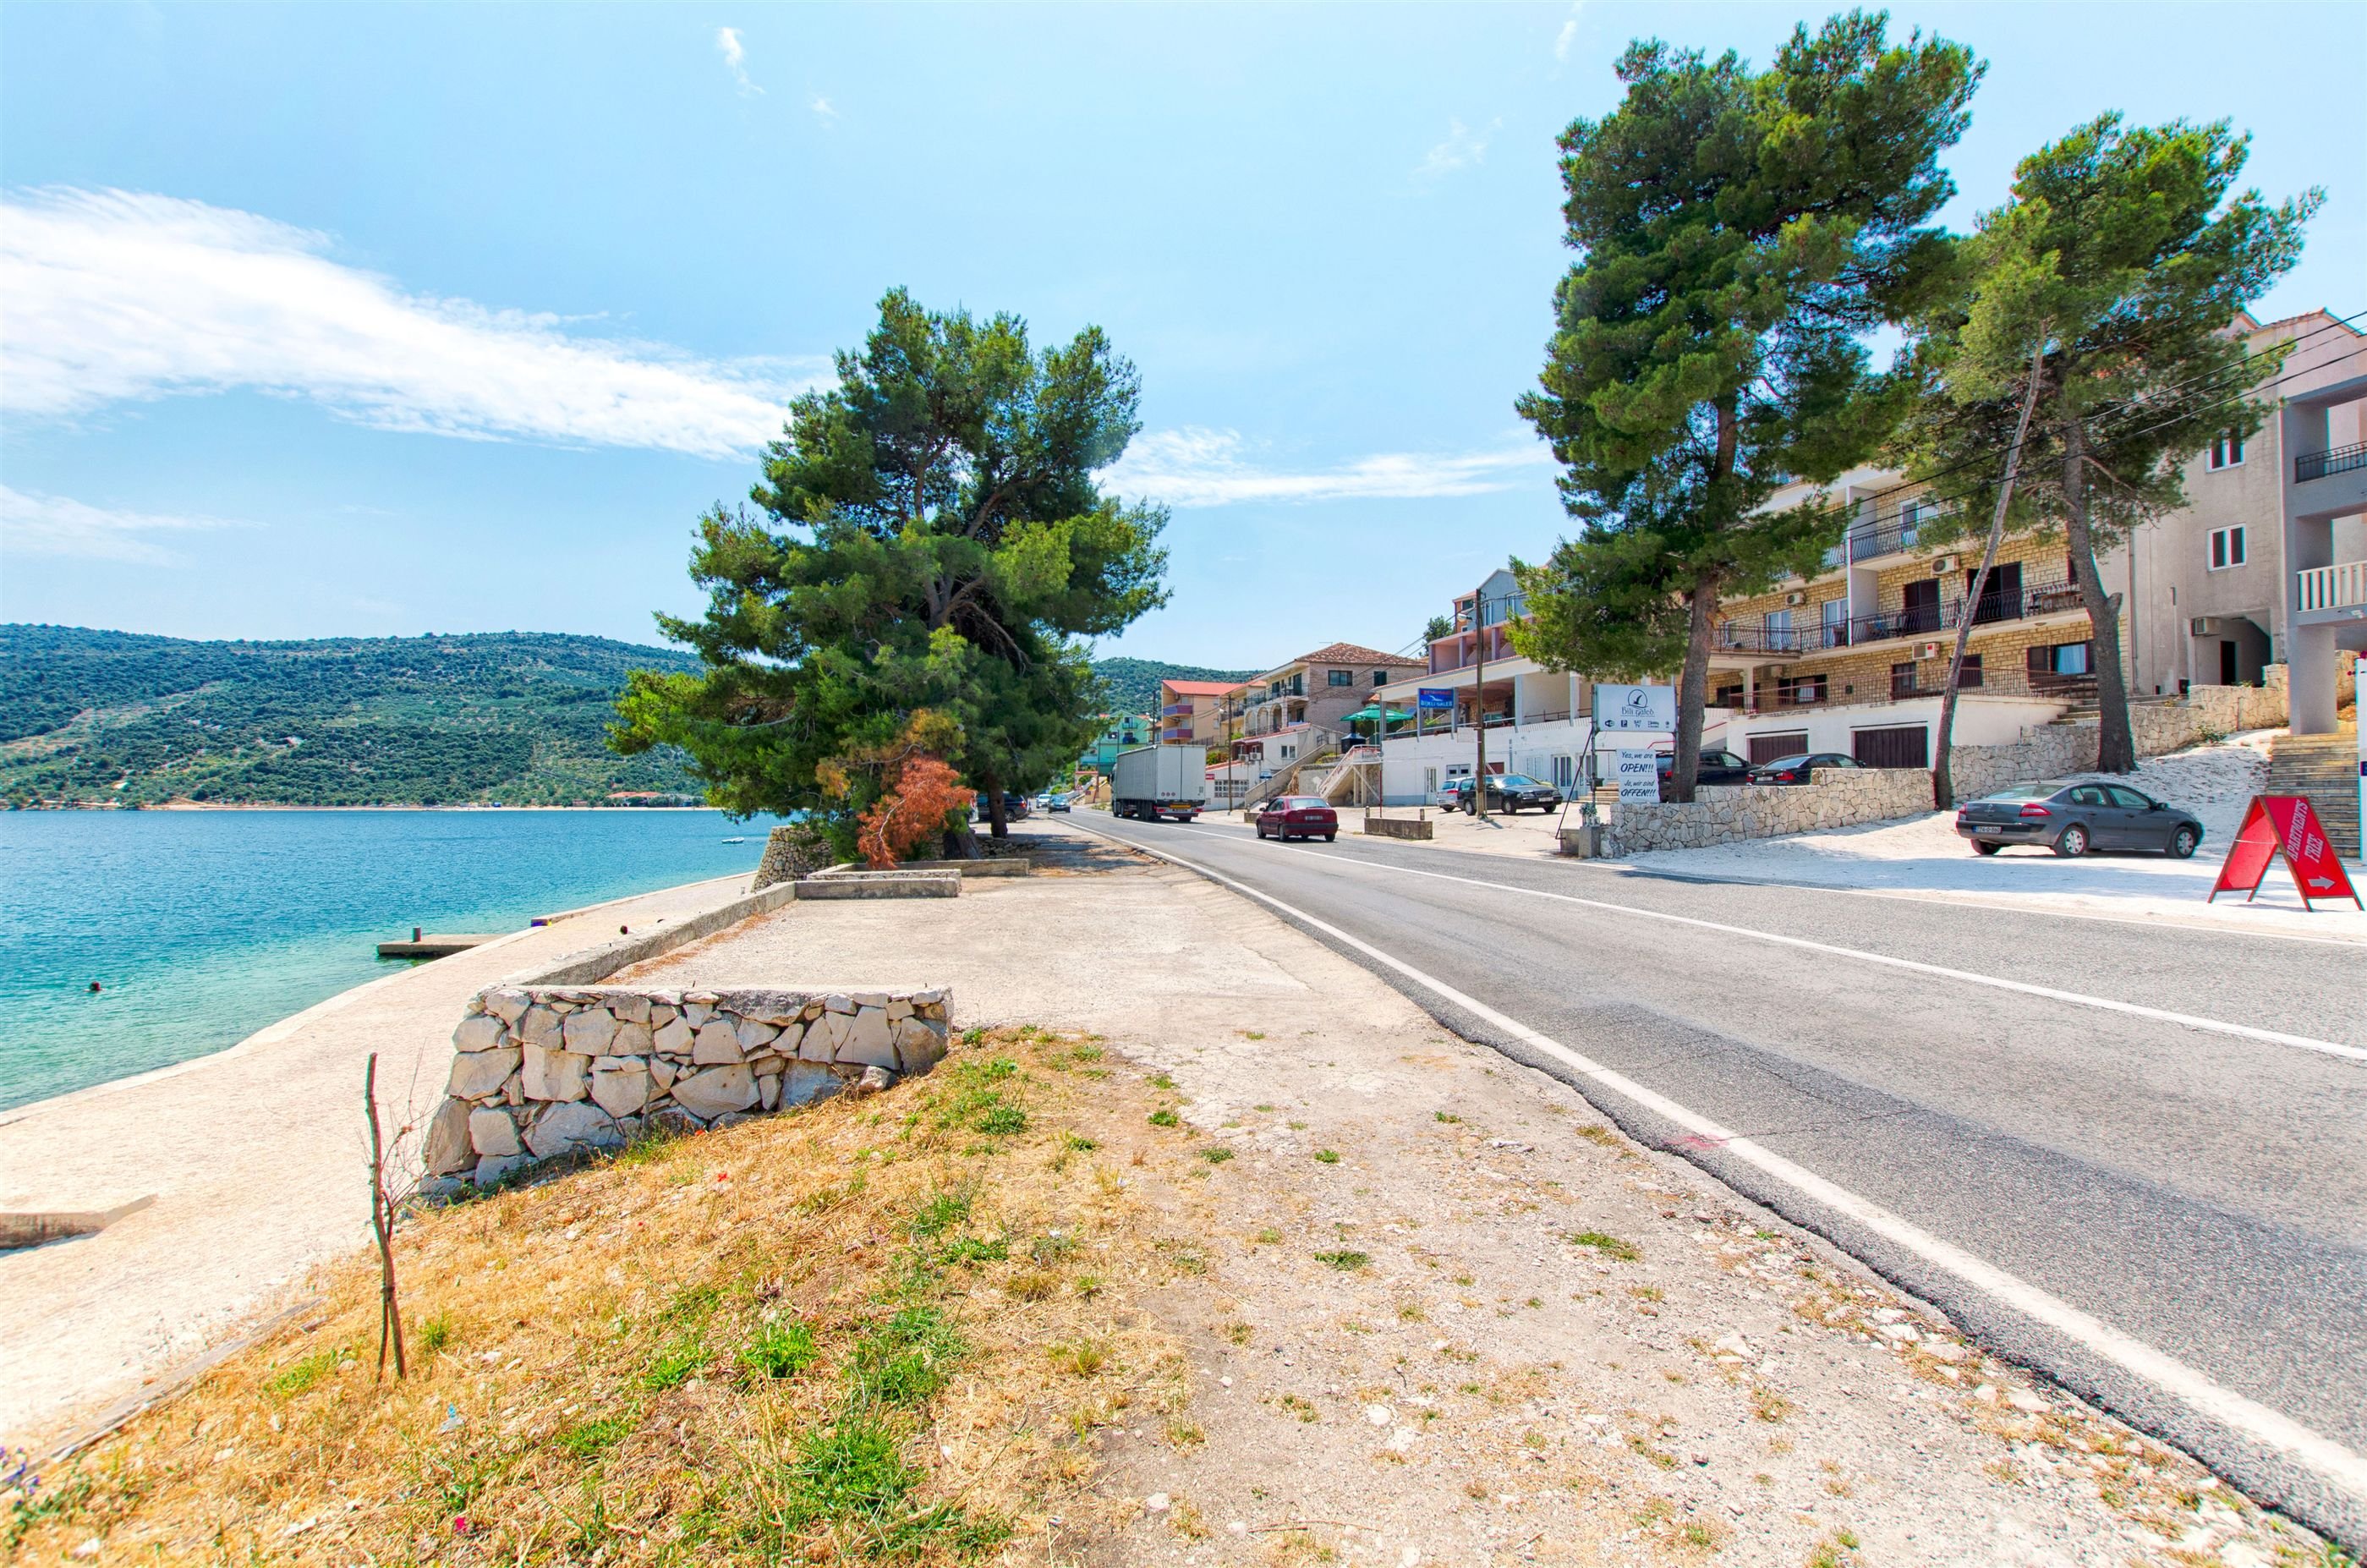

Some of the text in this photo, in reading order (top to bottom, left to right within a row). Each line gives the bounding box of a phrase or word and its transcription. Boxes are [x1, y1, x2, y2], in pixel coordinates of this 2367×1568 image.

[1622, 751, 1634, 759] Yes,
[1620, 763, 1654, 773] OPEN!!!
[1624, 779, 1633, 787] Ja,
[1620, 788, 1657, 798] OFFEN!!!
[2287, 799, 2308, 862] APARTMENTS
[2304, 832, 2324, 863] FREE
